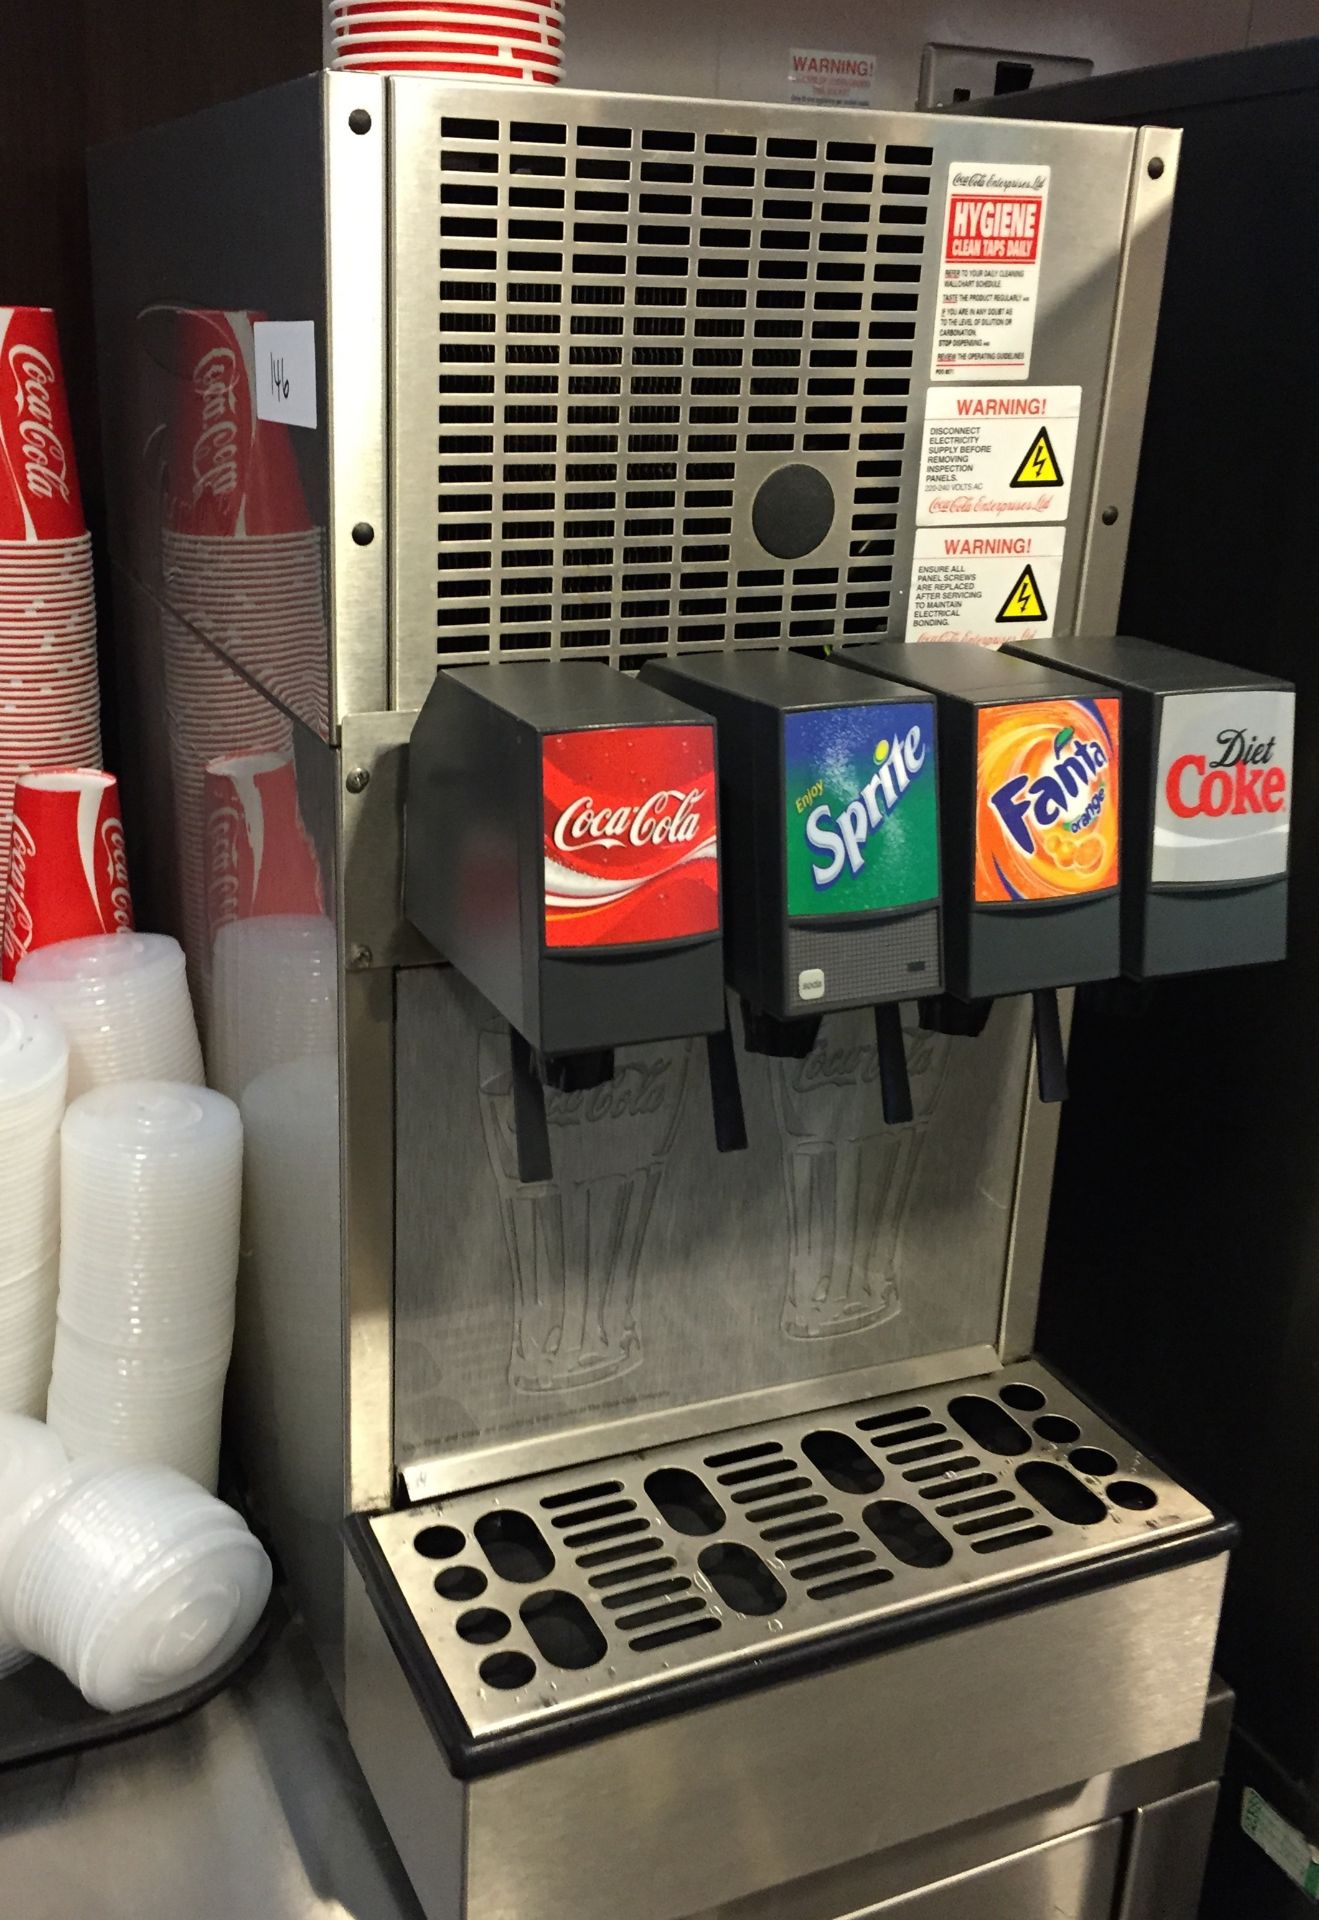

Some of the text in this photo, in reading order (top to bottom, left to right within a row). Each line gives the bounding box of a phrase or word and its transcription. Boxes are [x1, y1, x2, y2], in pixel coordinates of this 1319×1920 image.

[793, 55, 874, 77] WARNING!
[986, 174, 1030, 192] Enterprises
[953, 202, 1037, 238] HYGIENE
[952, 239, 1033, 257] CLEAN TAPS DAILY
[944, 280, 1001, 288] WALLCHART SCHEDULE
[943, 294, 958, 302] TASTE
[994, 294, 1022, 302] REGULARLY
[997, 352, 1024, 360] GUIDELINES
[270, 351, 290, 402] 146
[957, 398, 1047, 416] WARNING!
[930, 427, 981, 435] DISCONNECT
[929, 436, 979, 444] ELECTRICITY
[928, 446, 959, 454] SUPPLY
[928, 455, 969, 464] REMOVING
[926, 464, 974, 473] INSPECTION
[926, 474, 958, 482] PANELS.
[974, 496, 1031, 518] Enterprises
[944, 538, 1032, 555] WARNING!
[917, 574, 976, 582] PANEL SCREWS
[934, 582, 974, 590] REPLACED
[915, 591, 982, 600] AFTER SERVICING
[926, 600, 962, 608] MAINTAIN
[913, 618, 950, 627] BONDING.
[1208, 728, 1276, 768] Diet
[1165, 754, 1286, 819] Coke
[795, 778, 825, 814] Enjoy
[989, 739, 1109, 855] Fanta
[805, 725, 926, 887] Sprite
[1069, 787, 1105, 834] orange
[553, 788, 706, 852] Coca-Cola
